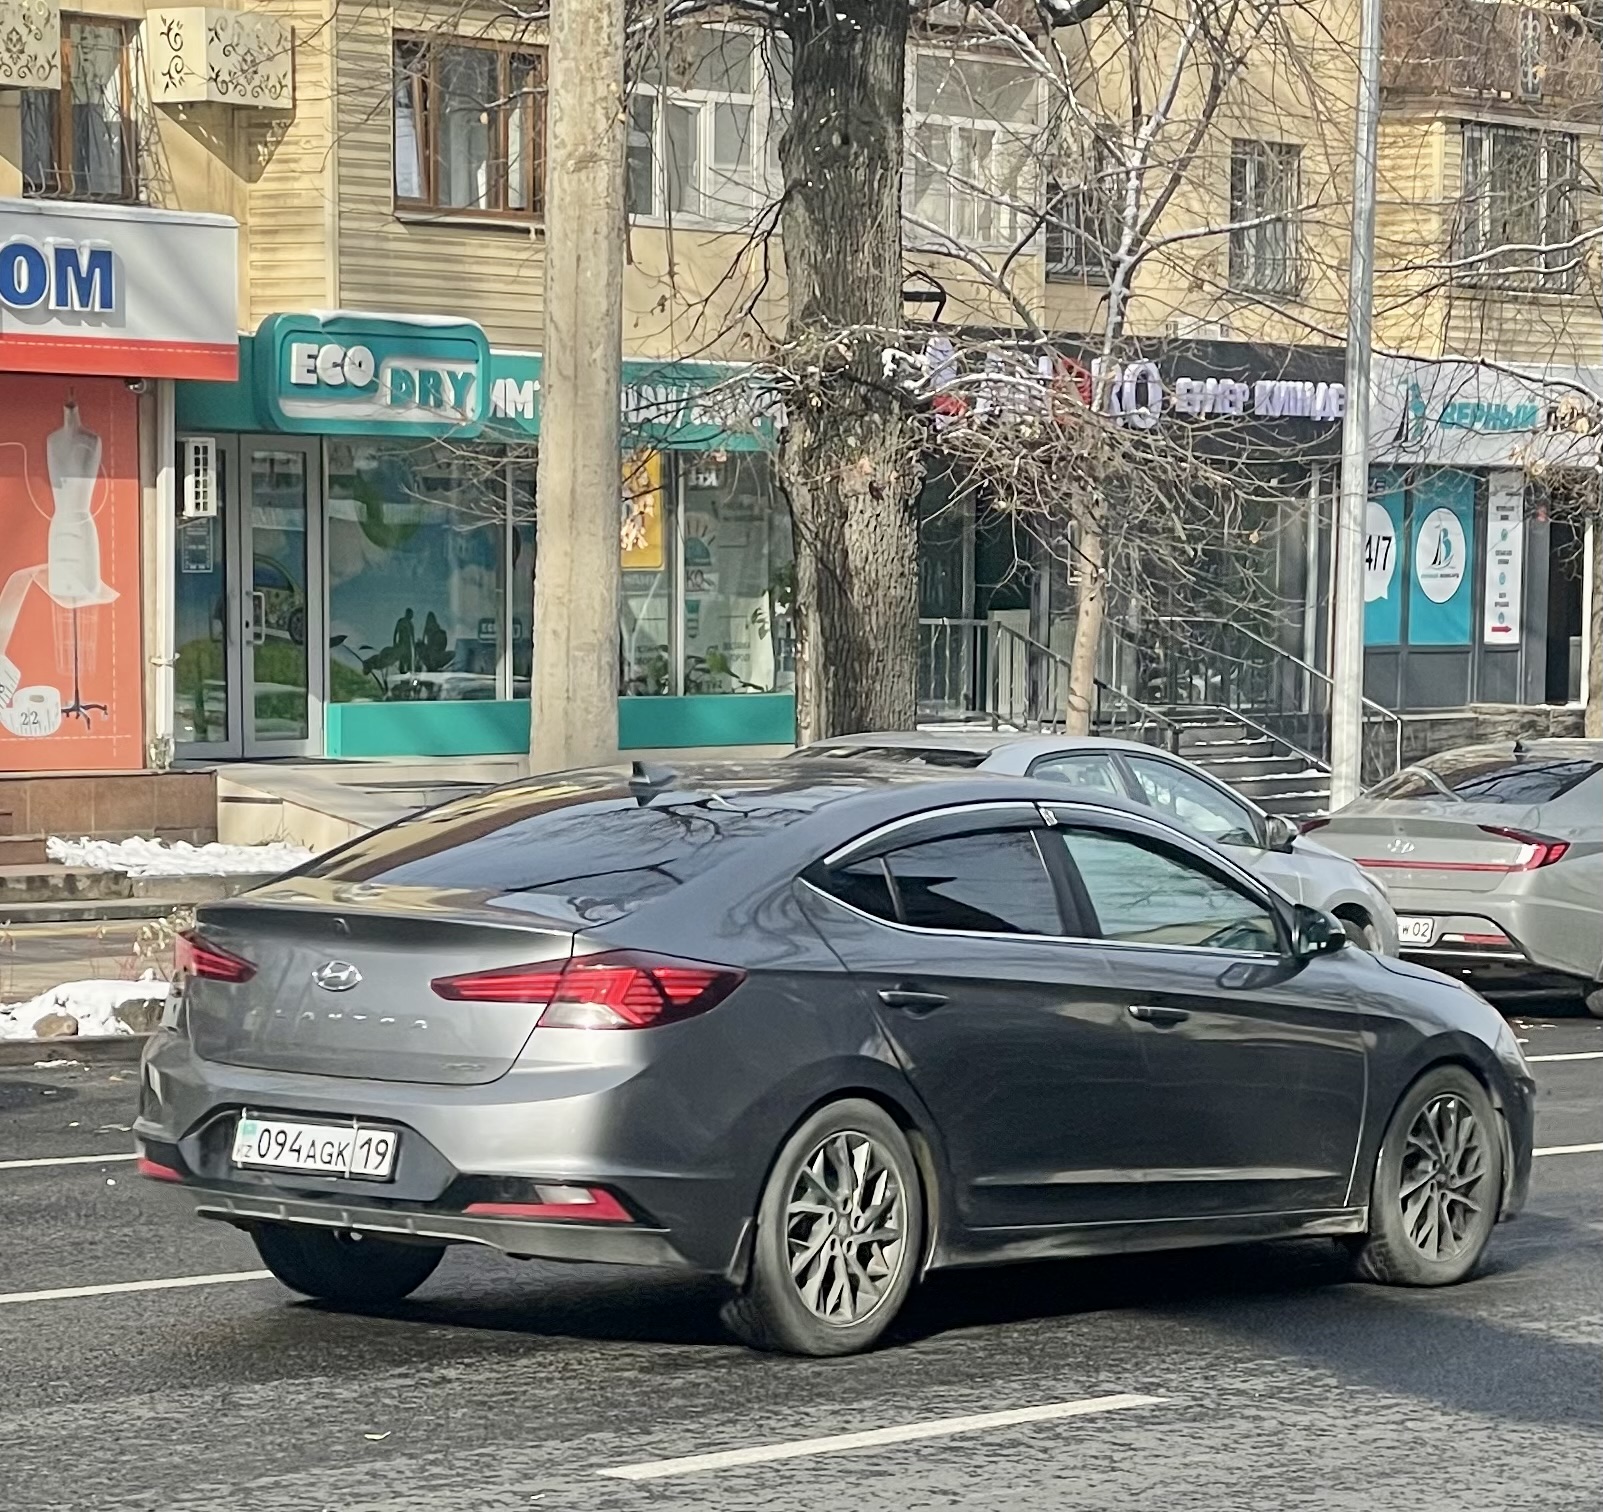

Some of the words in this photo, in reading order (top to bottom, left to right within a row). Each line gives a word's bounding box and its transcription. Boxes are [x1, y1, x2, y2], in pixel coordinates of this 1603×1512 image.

[291, 342, 375, 386] ECO
[386, 367, 476, 414] DRY
[20, 710, 39, 726] 22
[1412, 921, 1430, 938] 02
[359, 1136, 390, 1170] 19
